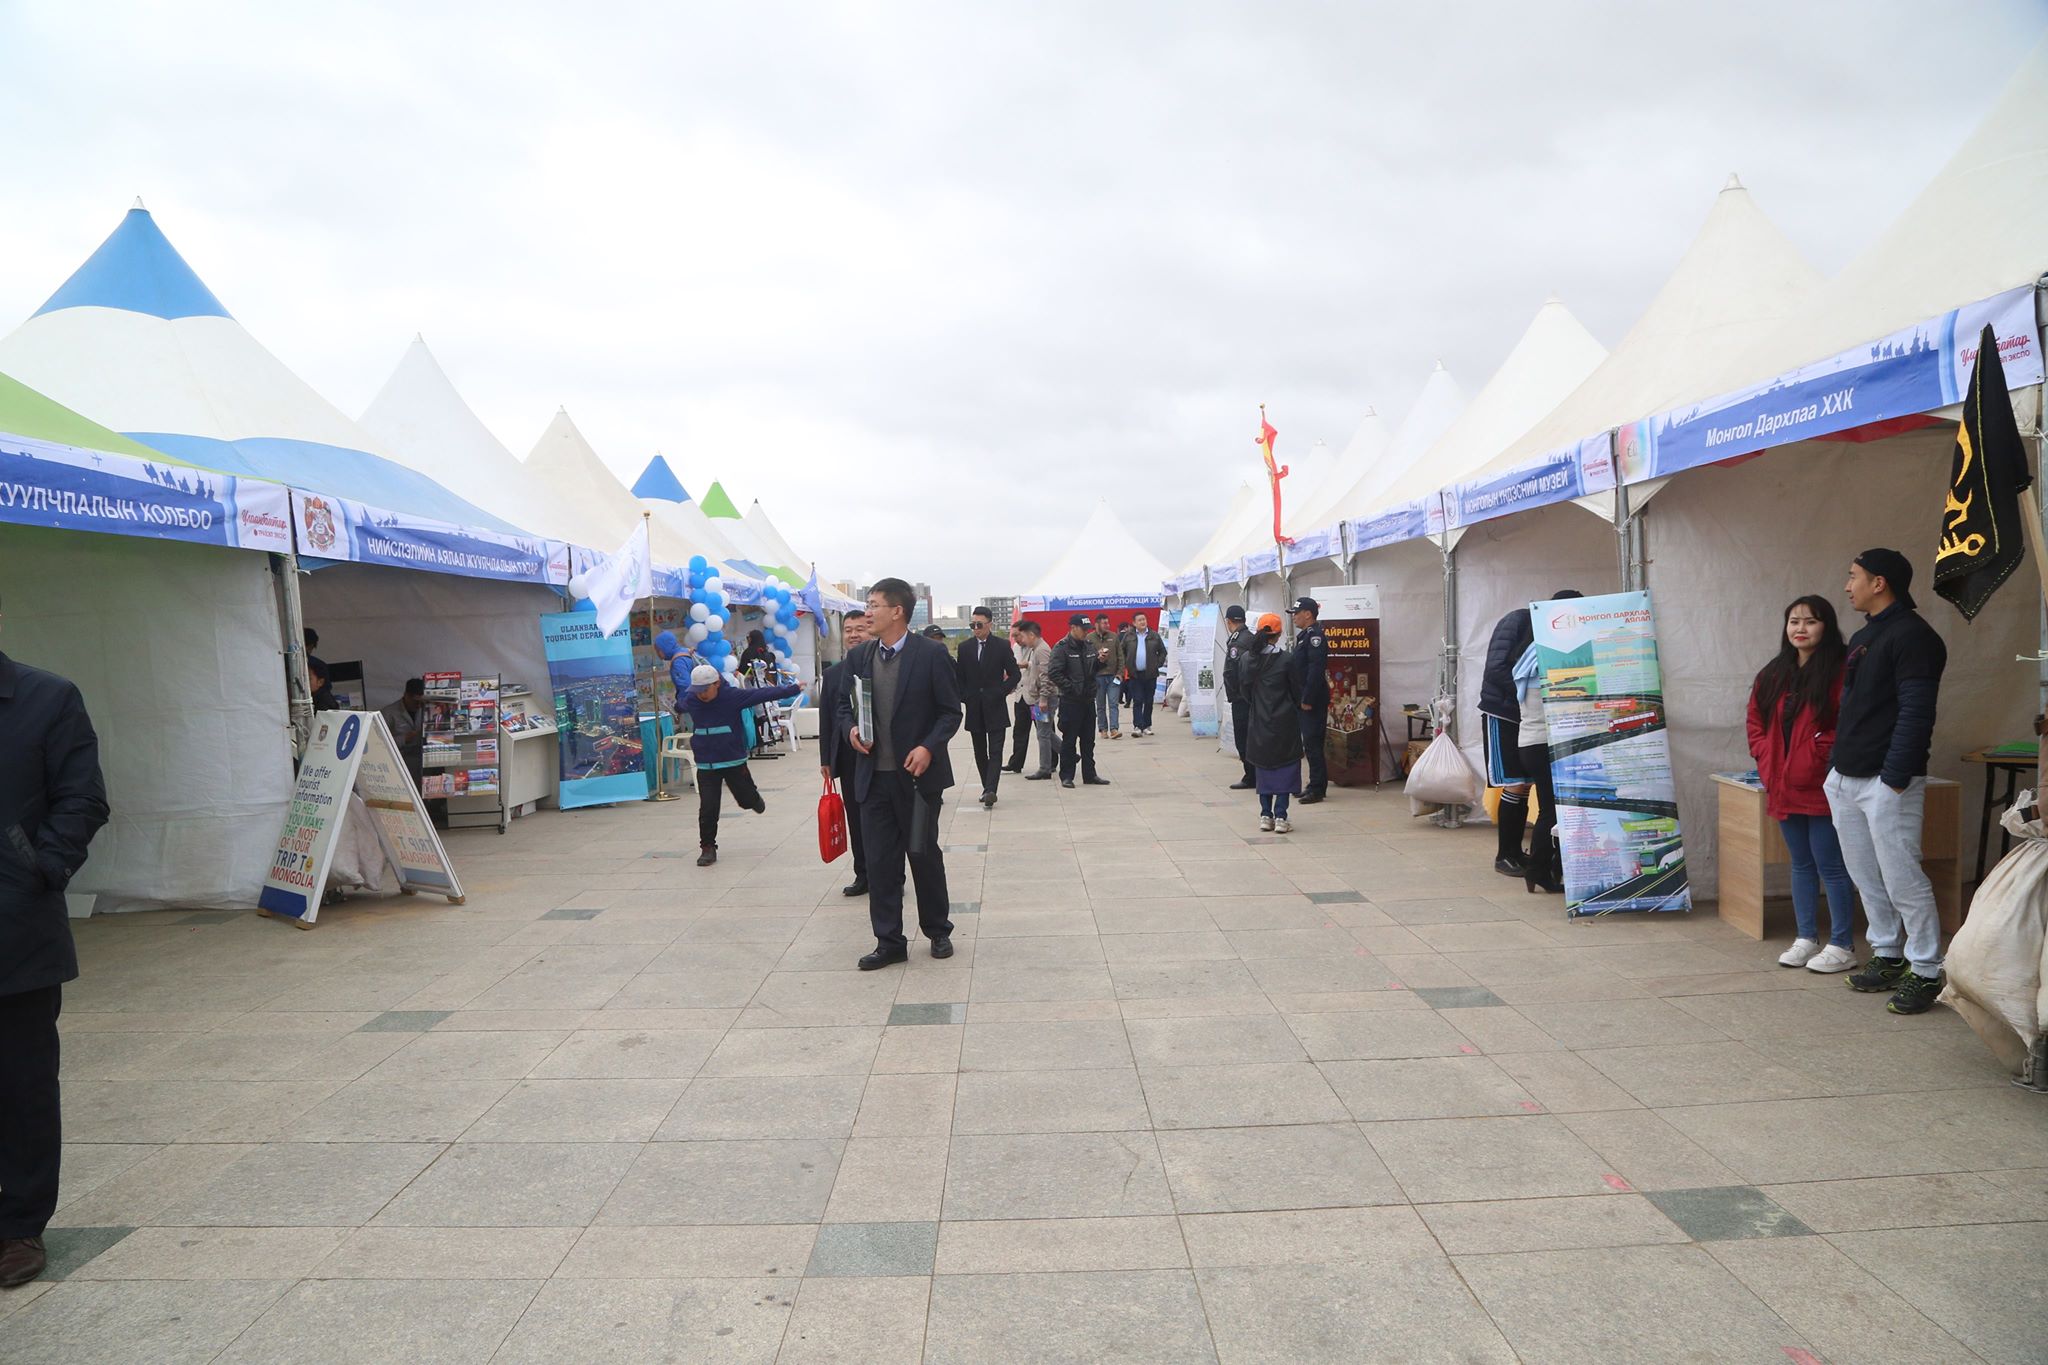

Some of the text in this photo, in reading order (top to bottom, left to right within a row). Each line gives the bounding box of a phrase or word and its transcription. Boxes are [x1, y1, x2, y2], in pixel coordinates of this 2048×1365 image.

[1705, 388, 1854, 447] Монгол Дархлаа ХХК
[1539, 466, 1568, 491] МУЗЕЙ
[139, 502, 212, 530] ХОЛБОО
[367, 535, 436, 563] НИЙСЛЭЛИЙН
[437, 548, 466, 567] АЯЛАЛ
[1105, 597, 1149, 605] КОРПОРАЦИ
[1578, 609, 1651, 623] МОНГОЛ ДАРХЛАА
[545, 629, 629, 643] TOURISM DEPARENT
[560, 623, 599, 633] ULAANBAA
[1322, 626, 1366, 638] АЙРЦГАН
[1340, 637, 1370, 648] МУЗЕЙ
[302, 765, 332, 779] We offer
[298, 778, 320, 790] tourist
[294, 789, 333, 805] information
[292, 800, 319, 816] TO HELP
[288, 813, 325, 831] YOU MAKE
[283, 825, 319, 842] THE MOST
[280, 836, 311, 854] OF YOUR
[276, 849, 298, 868] TRIP
[271, 866, 315, 889] MONGOLIA.
